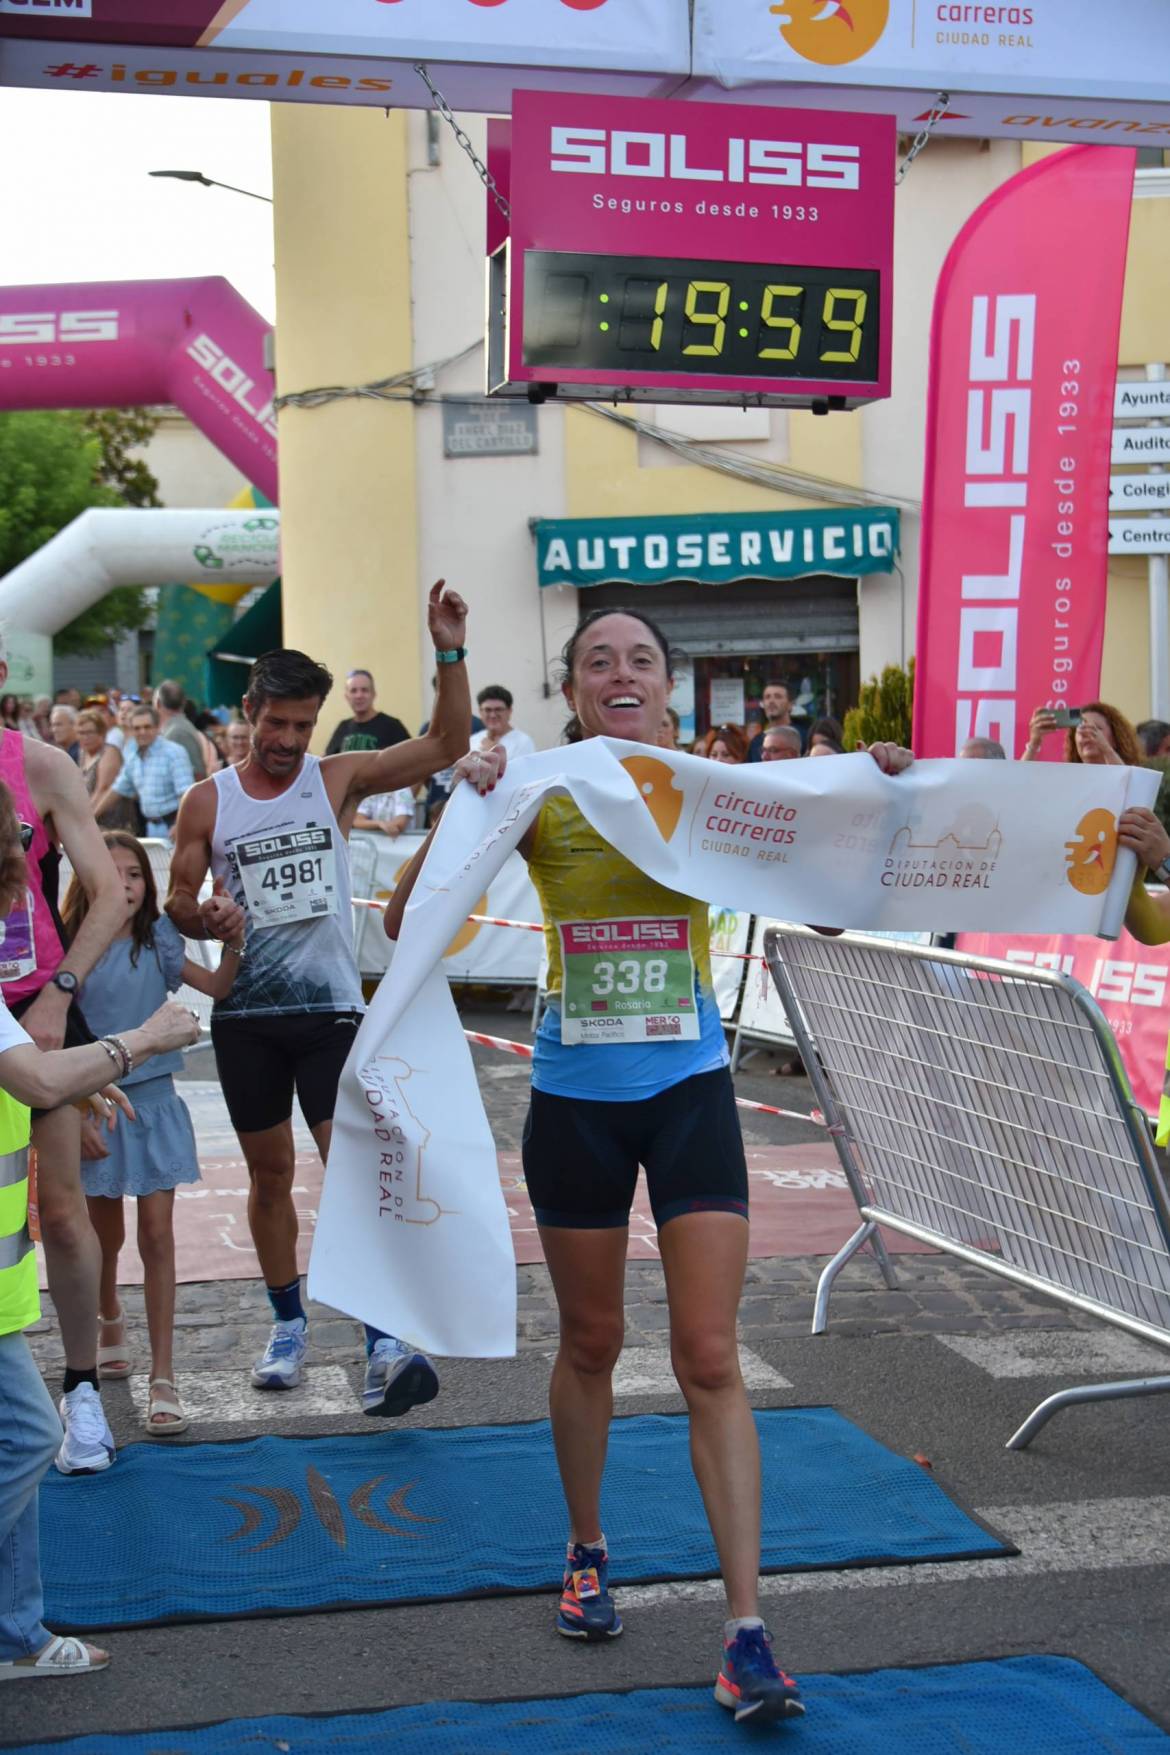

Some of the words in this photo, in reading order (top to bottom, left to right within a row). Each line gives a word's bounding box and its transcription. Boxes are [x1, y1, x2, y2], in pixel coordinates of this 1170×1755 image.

[937, 4, 1033, 25] carreras
[936, 31, 990, 46] CIUDAD
[998, 34, 1033, 48] REAL
[43, 62, 393, 92] #iguales
[551, 126, 860, 190] SOLISS
[593, 194, 684, 214] Seguros
[696, 201, 759, 218] desde
[772, 205, 819, 222] 1933
[25, 355, 76, 367] 1933
[1057, 359, 1080, 435] 1933
[1052, 456, 1076, 558] desde
[955, 294, 1036, 759] SOLISS
[543, 522, 893, 571] AUTOSERVICIO
[714, 790, 797, 822] circuito
[244, 830, 326, 858] SOLISS
[706, 814, 797, 844] carreras
[701, 838, 750, 859] CIUDAD
[757, 850, 789, 864] REAL
[980, 861, 997, 871] DE
[261, 858, 322, 891] 4981
[880, 871, 948, 887] CIUDAD
[952, 873, 990, 888] REAL
[572, 923, 679, 942] SOLISS
[592, 959, 668, 995] 338
[615, 1000, 652, 1010] Rosario
[379, 1152, 393, 1218] REAL
